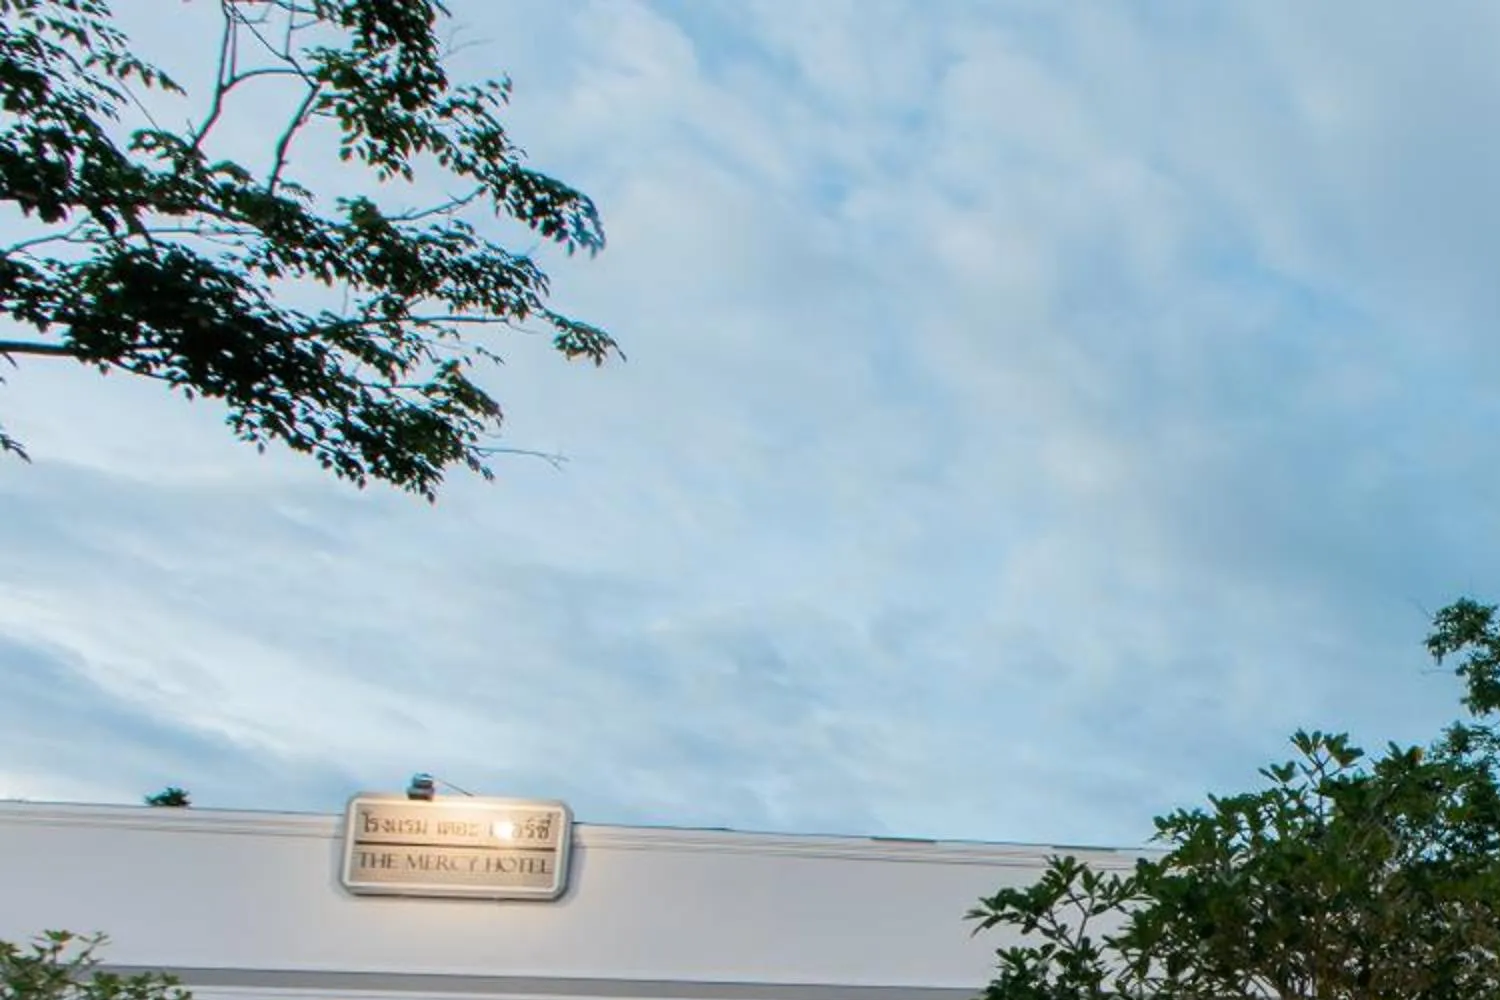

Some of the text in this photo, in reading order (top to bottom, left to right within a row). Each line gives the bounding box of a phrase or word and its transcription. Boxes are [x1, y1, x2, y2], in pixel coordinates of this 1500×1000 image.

[488, 813, 553, 840] เอร์ซี่
[358, 851, 552, 875] THE MERCY HOTEL
